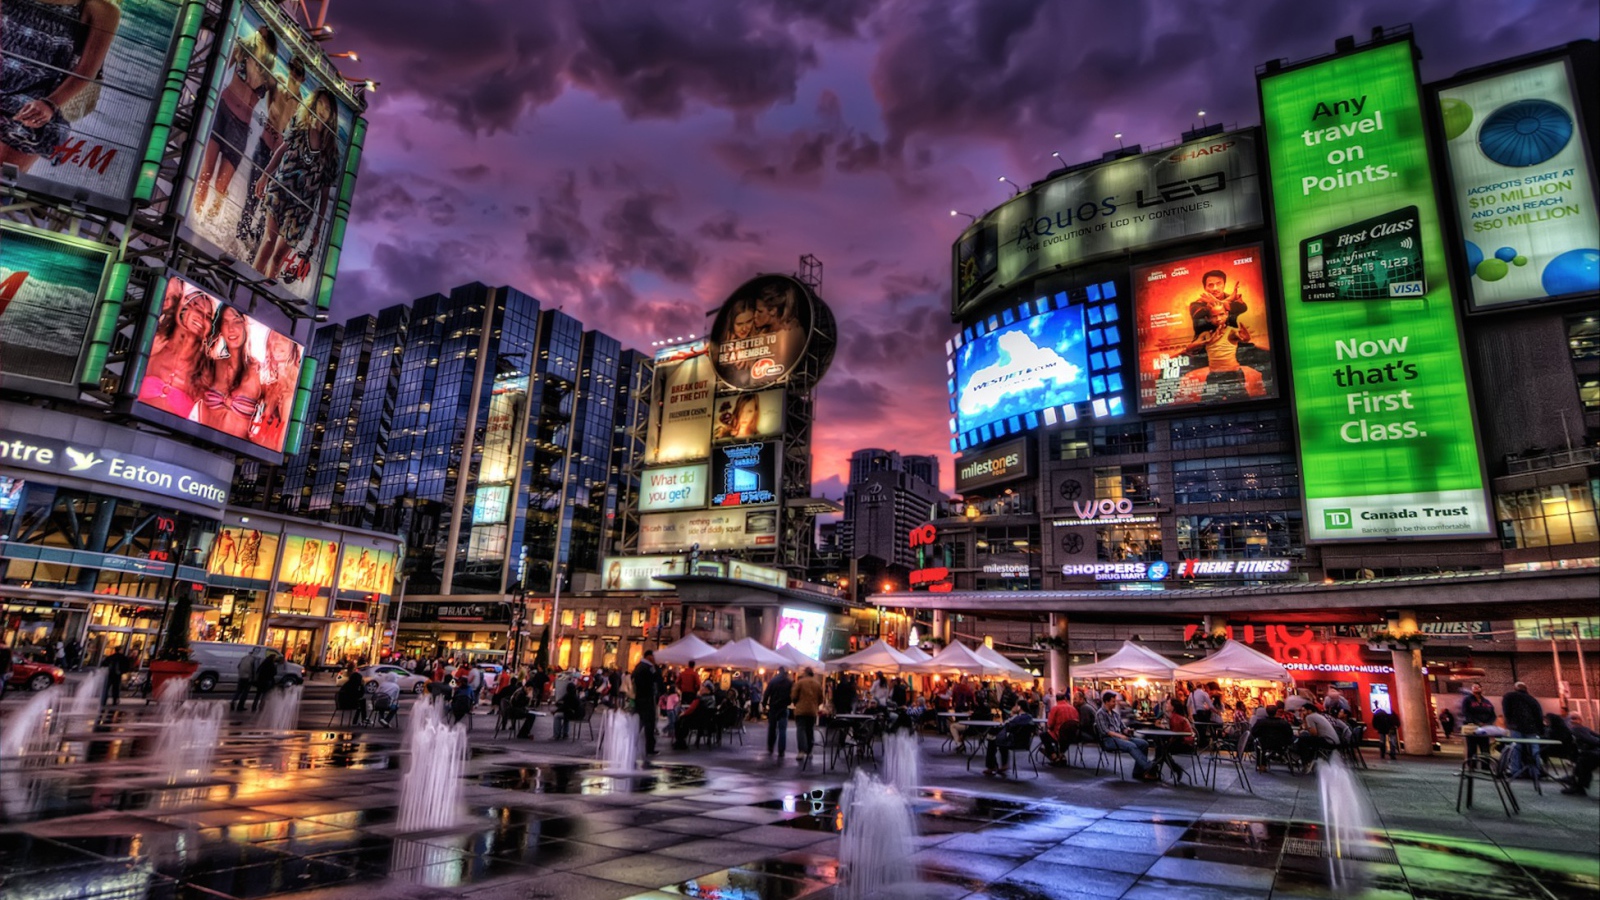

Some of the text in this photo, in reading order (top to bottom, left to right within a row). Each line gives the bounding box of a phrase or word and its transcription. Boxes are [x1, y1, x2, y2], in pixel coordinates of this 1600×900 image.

[1312, 95, 1367, 121] Any
[1301, 110, 1383, 146] travel
[49, 136, 118, 175] H&M
[1170, 141, 1236, 164] SHARP
[1327, 145, 1364, 165] on
[1302, 164, 1398, 196] Points.
[1467, 168, 1576, 196] JACKPOTS START AT
[1469, 180, 1573, 209] $10 MILLION
[1017, 171, 1227, 246] AQUOS LED
[1471, 196, 1564, 219] AND CAN REACH
[1473, 203, 1580, 233] $50 MILLION
[1026, 201, 1213, 254] THE EVOLUTION OF LCD TV CONTINUES.
[1336, 218, 1415, 248] First Class
[1325, 257, 1340, 265] VISA
[1327, 267, 1347, 277] 1234
[1380, 256, 1409, 269] 9123
[1393, 284, 1421, 294] VISA
[719, 346, 771, 362] BE A MEMBER.
[720, 335, 777, 352] IT'S BETTER TO
[1335, 336, 1408, 360] Now
[1153, 355, 1190, 370] Karate
[1163, 367, 1180, 379] Kid
[1333, 360, 1418, 387] that's
[671, 379, 708, 394] BREAK OUT
[671, 389, 709, 404] OF THE CITY
[1347, 389, 1414, 415] First
[1340, 419, 1427, 443] Class.
[962, 453, 1019, 479] milestones
[108, 457, 226, 503] Eaton Centre
[651, 470, 695, 487] What did
[648, 486, 691, 505] you get?
[1073, 498, 1133, 519] WOO
[1326, 506, 1468, 526] TD Canada Trust
[700, 526, 707, 534] of
[1361, 526, 1390, 535] Banking
[1413, 524, 1427, 532] this
[1427, 523, 1472, 532] comfortable
[983, 563, 1029, 573] milestones
[1062, 562, 1147, 575] SHOPPERS
[1095, 572, 1146, 581] DRUG MART
[1177, 558, 1291, 579] EXTREME FITNESS
[1287, 663, 1390, 673] OPERA COMEDY MUSIC
